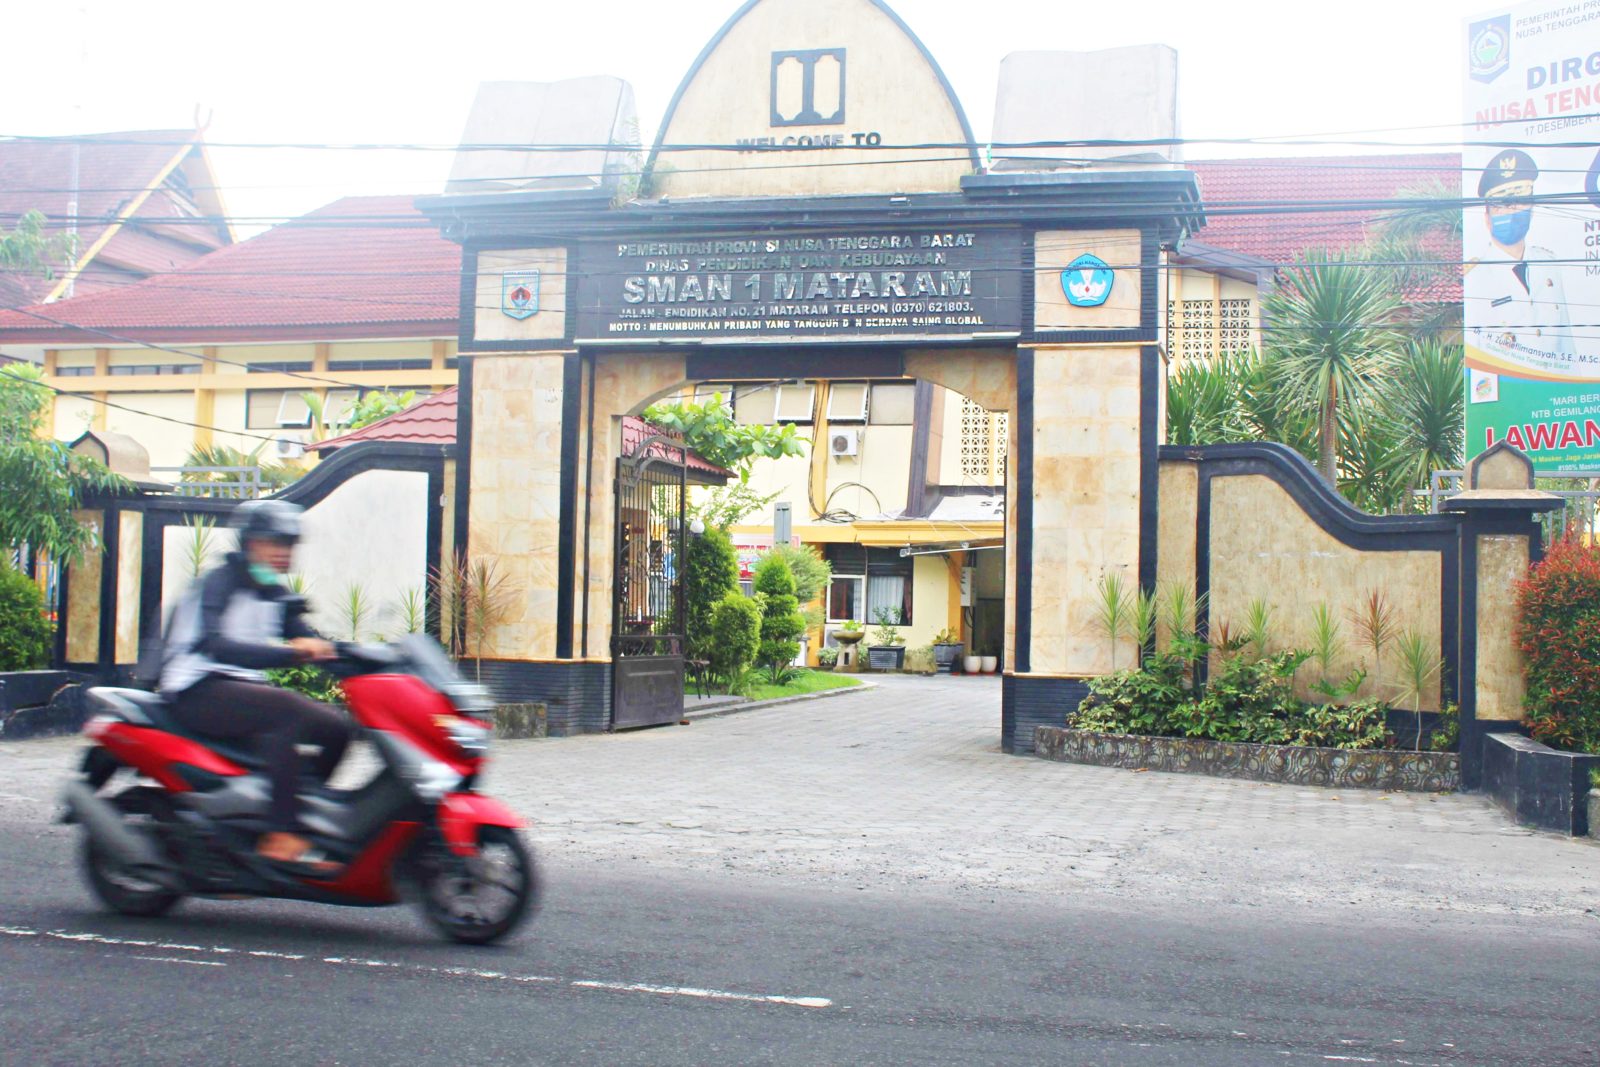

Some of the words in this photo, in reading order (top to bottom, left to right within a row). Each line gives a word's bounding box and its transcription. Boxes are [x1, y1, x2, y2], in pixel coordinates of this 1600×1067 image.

[1515, 4, 1580, 27] PEMERINTAH
[1515, 26, 1542, 40] NUSA
[1475, 98, 1538, 131] NUSA
[1537, 116, 1592, 134] DESEMBER
[735, 134, 845, 154] WELCOME
[851, 132, 881, 147] TO
[618, 241, 712, 257] PEMERINTAH
[783, 238, 825, 251] NUSA
[827, 235, 913, 250] TENGGARA
[920, 233, 975, 247] BARAT
[646, 259, 689, 272] DINAS
[801, 254, 832, 268] DAN
[839, 252, 947, 267] KEBUDAYAAN
[623, 273, 732, 304] SMAN
[744, 273, 761, 300] 1
[773, 270, 972, 301] MATARAM
[618, 308, 655, 319] JALAN
[662, 306, 727, 318] ENDIDIKAN
[730, 306, 750, 317] NO.
[752, 306, 766, 316] 21
[769, 304, 828, 316] MATARAM
[834, 302, 888, 314] TELEPON
[891, 301, 926, 314] (0370)
[928, 301, 974, 313] 621803.
[609, 321, 641, 332] MOTTO
[649, 320, 721, 331] MENUMBUHKAN
[724, 320, 761, 330] PRIBADI
[765, 319, 791, 329] YANG
[794, 319, 839, 329] TANGGUH
[842, 318, 862, 327] DN
[866, 317, 908, 327] BERDAYA
[912, 316, 941, 326] SAING
[945, 315, 984, 325] GLOBAL
[1531, 409, 1551, 419] NTB
